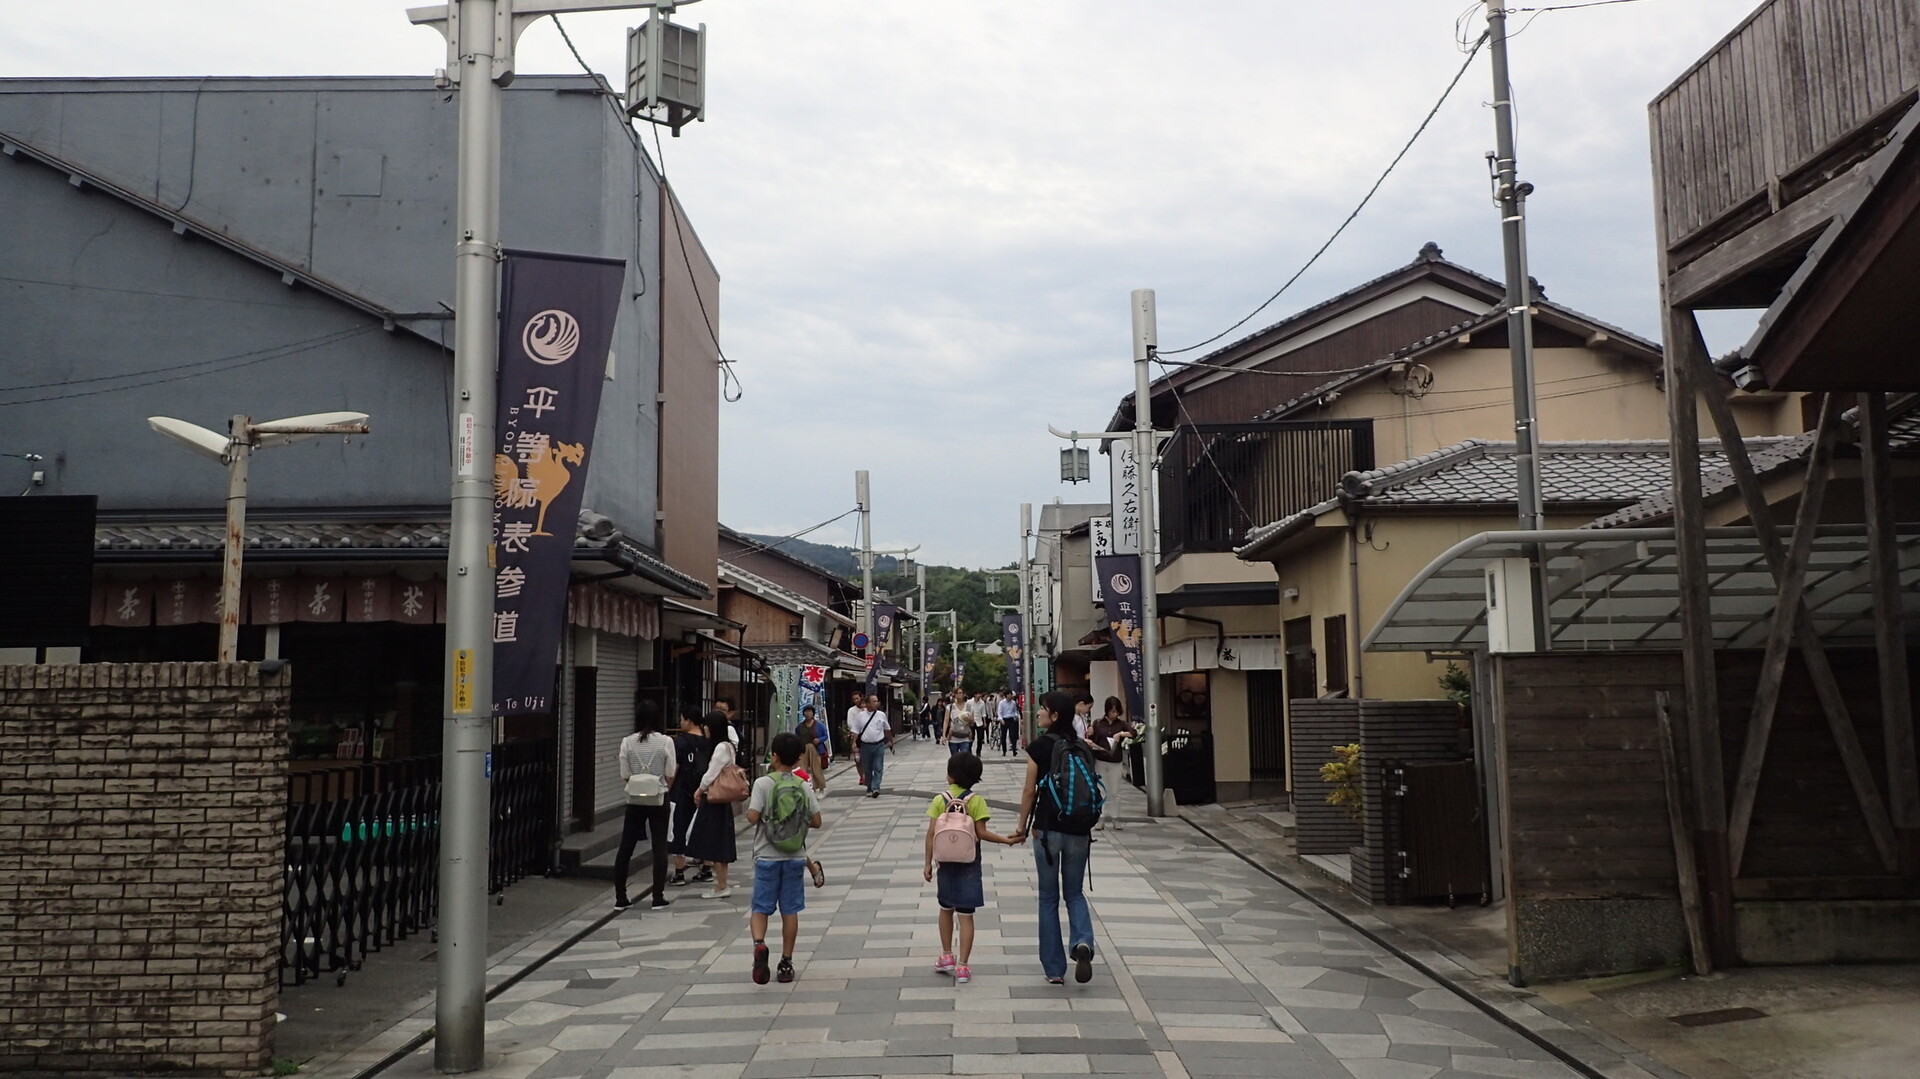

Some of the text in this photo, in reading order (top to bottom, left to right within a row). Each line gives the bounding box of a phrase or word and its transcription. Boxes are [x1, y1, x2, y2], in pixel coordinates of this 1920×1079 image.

[493, 386, 559, 643] 平等院表参道
[402, 585, 424, 618] 茶
[1221, 647, 1236, 662] 茶
[505, 697, 518, 711] To
[524, 695, 545, 711] Uji
